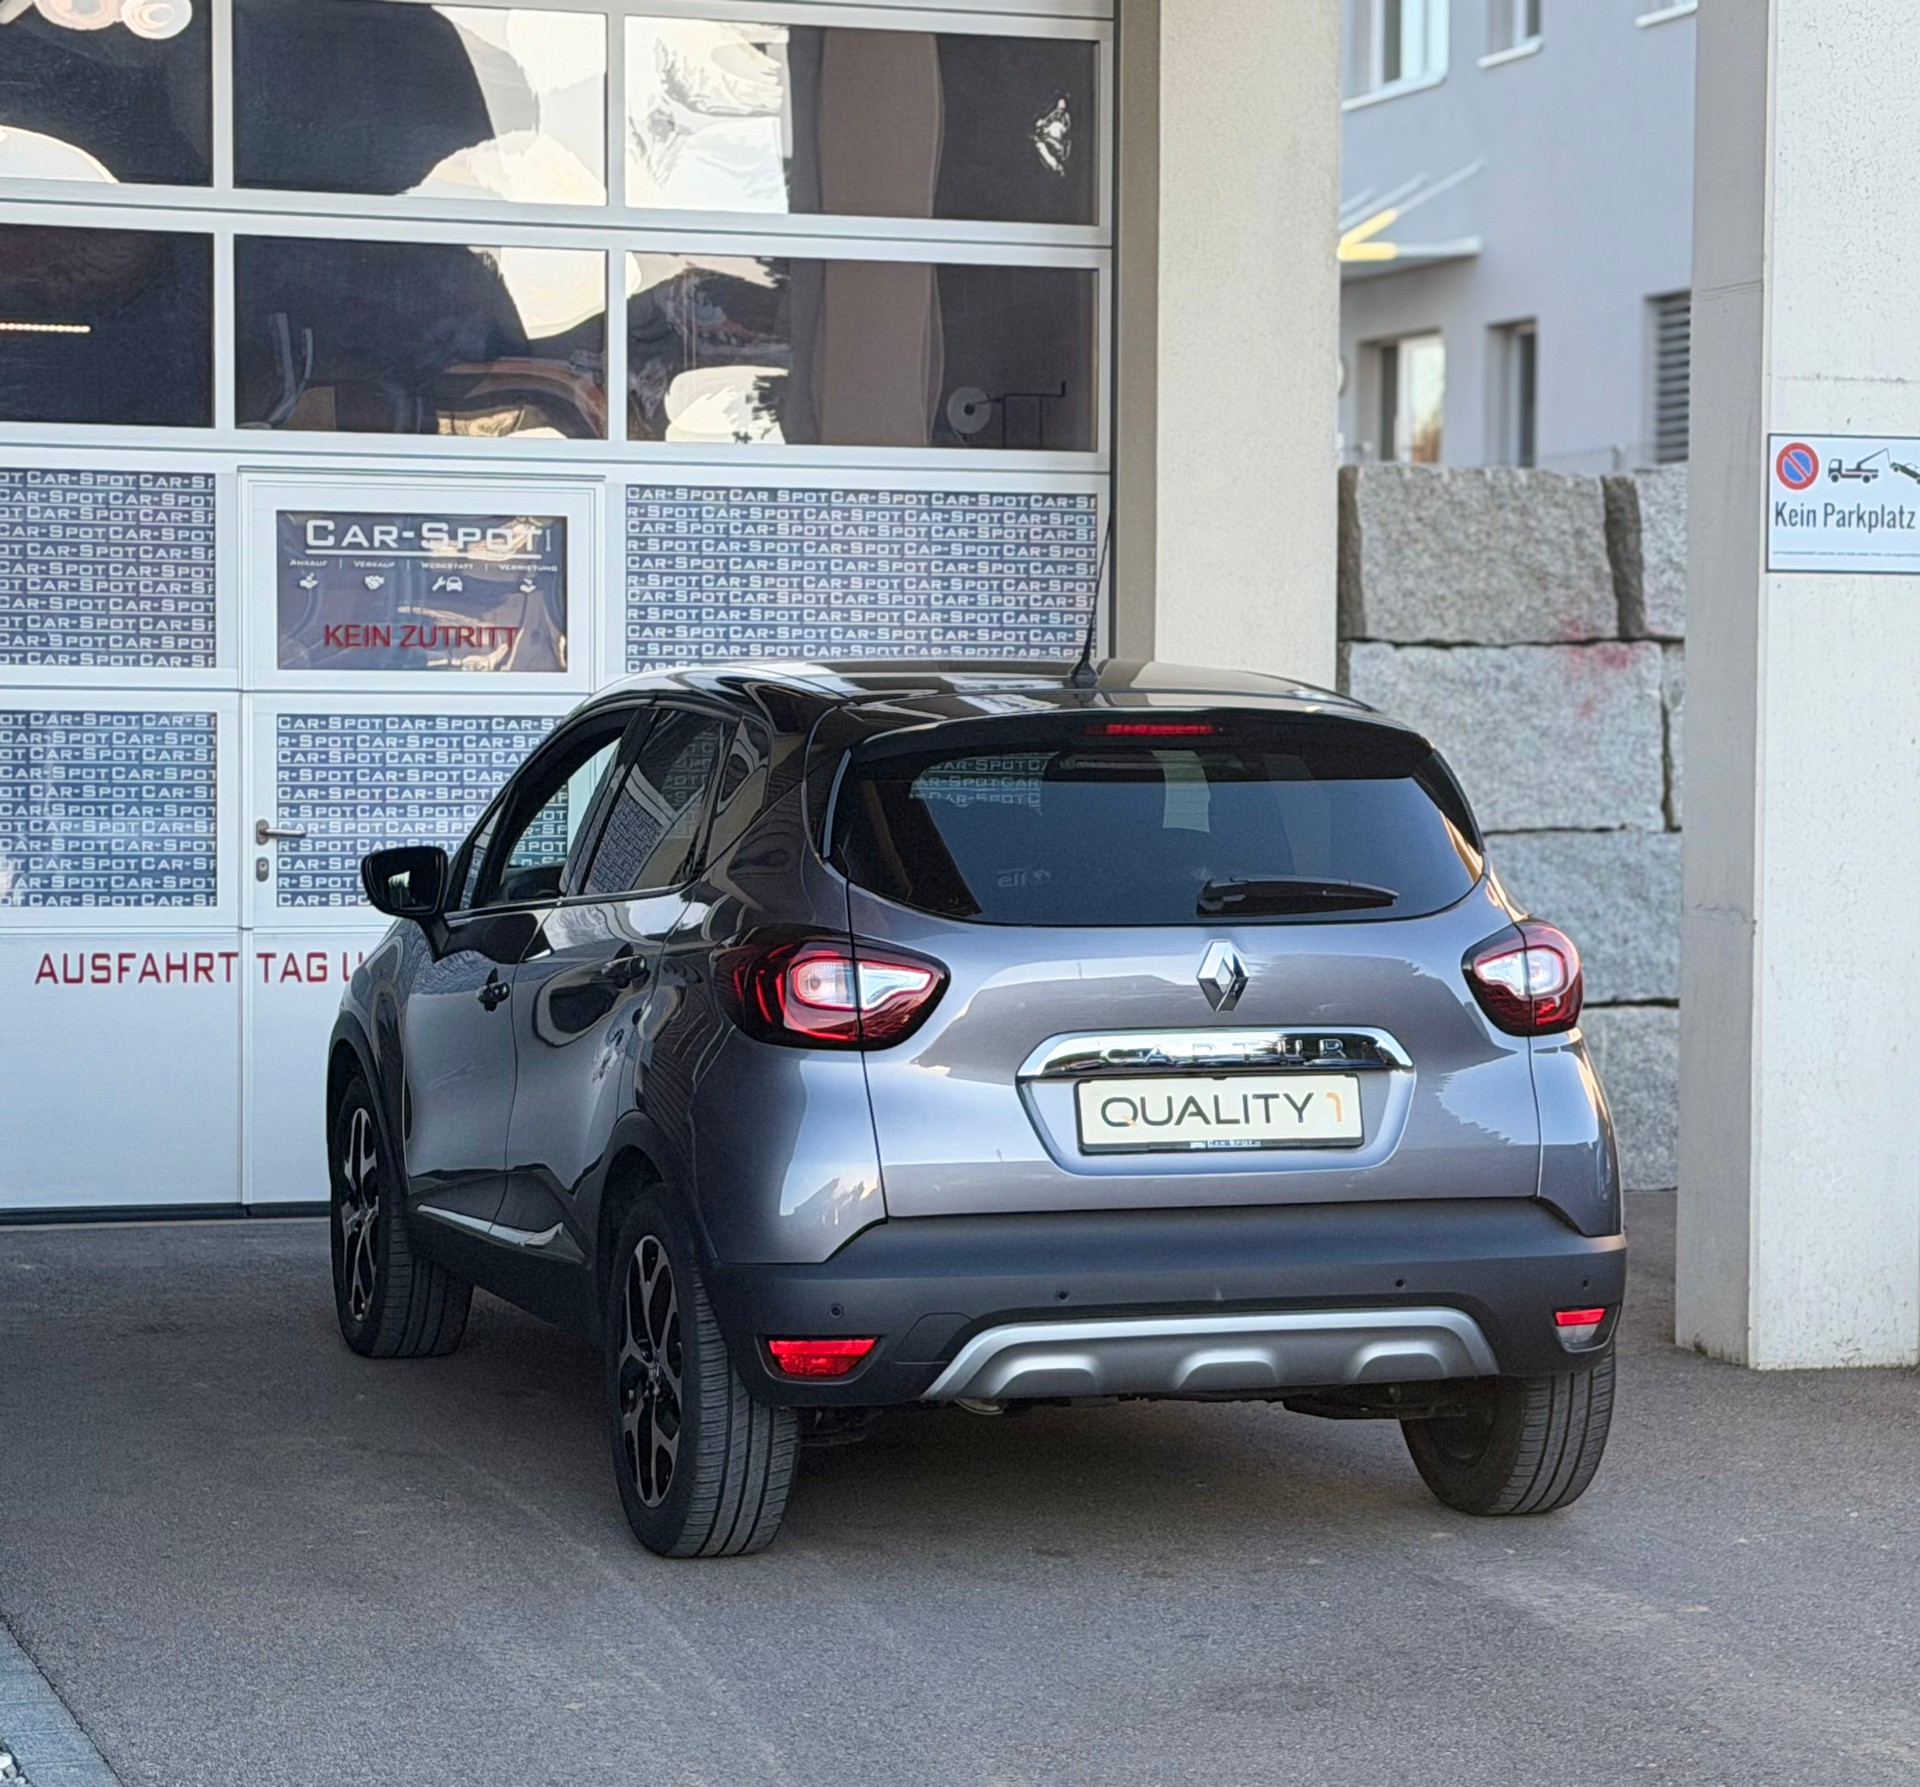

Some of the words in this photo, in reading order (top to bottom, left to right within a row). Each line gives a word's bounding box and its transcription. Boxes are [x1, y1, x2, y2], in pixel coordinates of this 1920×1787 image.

[27, 472, 136, 487] CAR-SPOT
[627, 488, 726, 502] CAR-SPOT
[831, 492, 928, 506] CAR-SPOT
[931, 494, 1028, 508] CAR-SPOT
[27, 507, 136, 522] CAR-SPOT
[702, 506, 801, 520] CAR-SPOT
[803, 508, 901, 522] CAR-SPOT
[904, 510, 1001, 524] CAR-SPOT
[1775, 501, 1816, 528] Kein
[1823, 502, 1916, 533] Parkplatz
[306, 520, 542, 551] CAR-SPOT
[627, 522, 726, 535] CAR-SPOT
[729, 523, 828, 537] CAR-SPOT
[831, 525, 928, 538] CAR-SPOT
[931, 526, 1028, 540] CAR-SPOT
[27, 544, 136, 558] CAR-SPOT
[702, 540, 801, 554] CAR-SPOT
[803, 541, 901, 555] CAR-SPOT
[627, 557, 726, 571] CAR-SPOT
[729, 559, 828, 572] CAR-SPOT
[831, 560, 928, 574] CAR-SPOT
[931, 562, 1028, 575] CAR-SPOT
[27, 578, 136, 593] CAR-SPOT
[702, 575, 801, 589] CAR-SPOT
[803, 577, 901, 590] CAR-SPOT
[904, 578, 1001, 591] CAR-SPOT
[627, 590, 726, 603] CAR-SPOT
[729, 591, 828, 605] CAR-SPOT
[831, 593, 928, 606] CAR-SPOT
[931, 594, 1028, 607] CAR-SPOT
[27, 615, 136, 630] CAR-SPOT
[702, 608, 801, 621] CAR-SPOT
[803, 609, 901, 623] CAR-SPOT
[904, 611, 1001, 624] CAR-SPOT
[324, 624, 391, 648] KEIN
[401, 626, 518, 648] ZUTRITT
[627, 625, 726, 639] CAR-SPOT
[729, 627, 828, 640] CAR-SPOT
[831, 628, 928, 641] CAR-SPOT
[931, 629, 1028, 642] CAR-SPOT
[702, 645, 801, 657] CAR-SPOT
[27, 653, 136, 667] CAR-SPOT
[30, 713, 139, 726] CAR-SPOT
[278, 717, 383, 730] CAR-SPOT
[386, 718, 490, 730] CAR-SPOT
[0, 731, 108, 744] CAR-SPOT
[357, 735, 461, 748] CAR-SPOT
[30, 748, 139, 760] CAR-SPOT
[278, 751, 383, 763] CAR-SPOT
[386, 752, 490, 764] CAR-SPOT
[0, 767, 108, 780] CAR-SPOT
[357, 769, 461, 781] CAR-SPOT
[30, 786, 139, 798] CAR-SPOT
[278, 788, 383, 799] CAR-SPOT
[386, 788, 489, 799] CAR-SPOT
[0, 804, 108, 816] CAR-SPOT
[357, 806, 461, 817] CAR-SPOT
[30, 820, 139, 832] CAR-SPOT
[0, 839, 107, 851] CAR-SPOT
[29, 858, 138, 870] CAR-SPOT
[29, 895, 138, 907] CAR-SPOT
[35, 952, 239, 984] AUSFAHRT
[257, 953, 328, 983] TAG
[1101, 1092, 1314, 1128] QUALITY
[1326, 1092, 1342, 1122] 1
